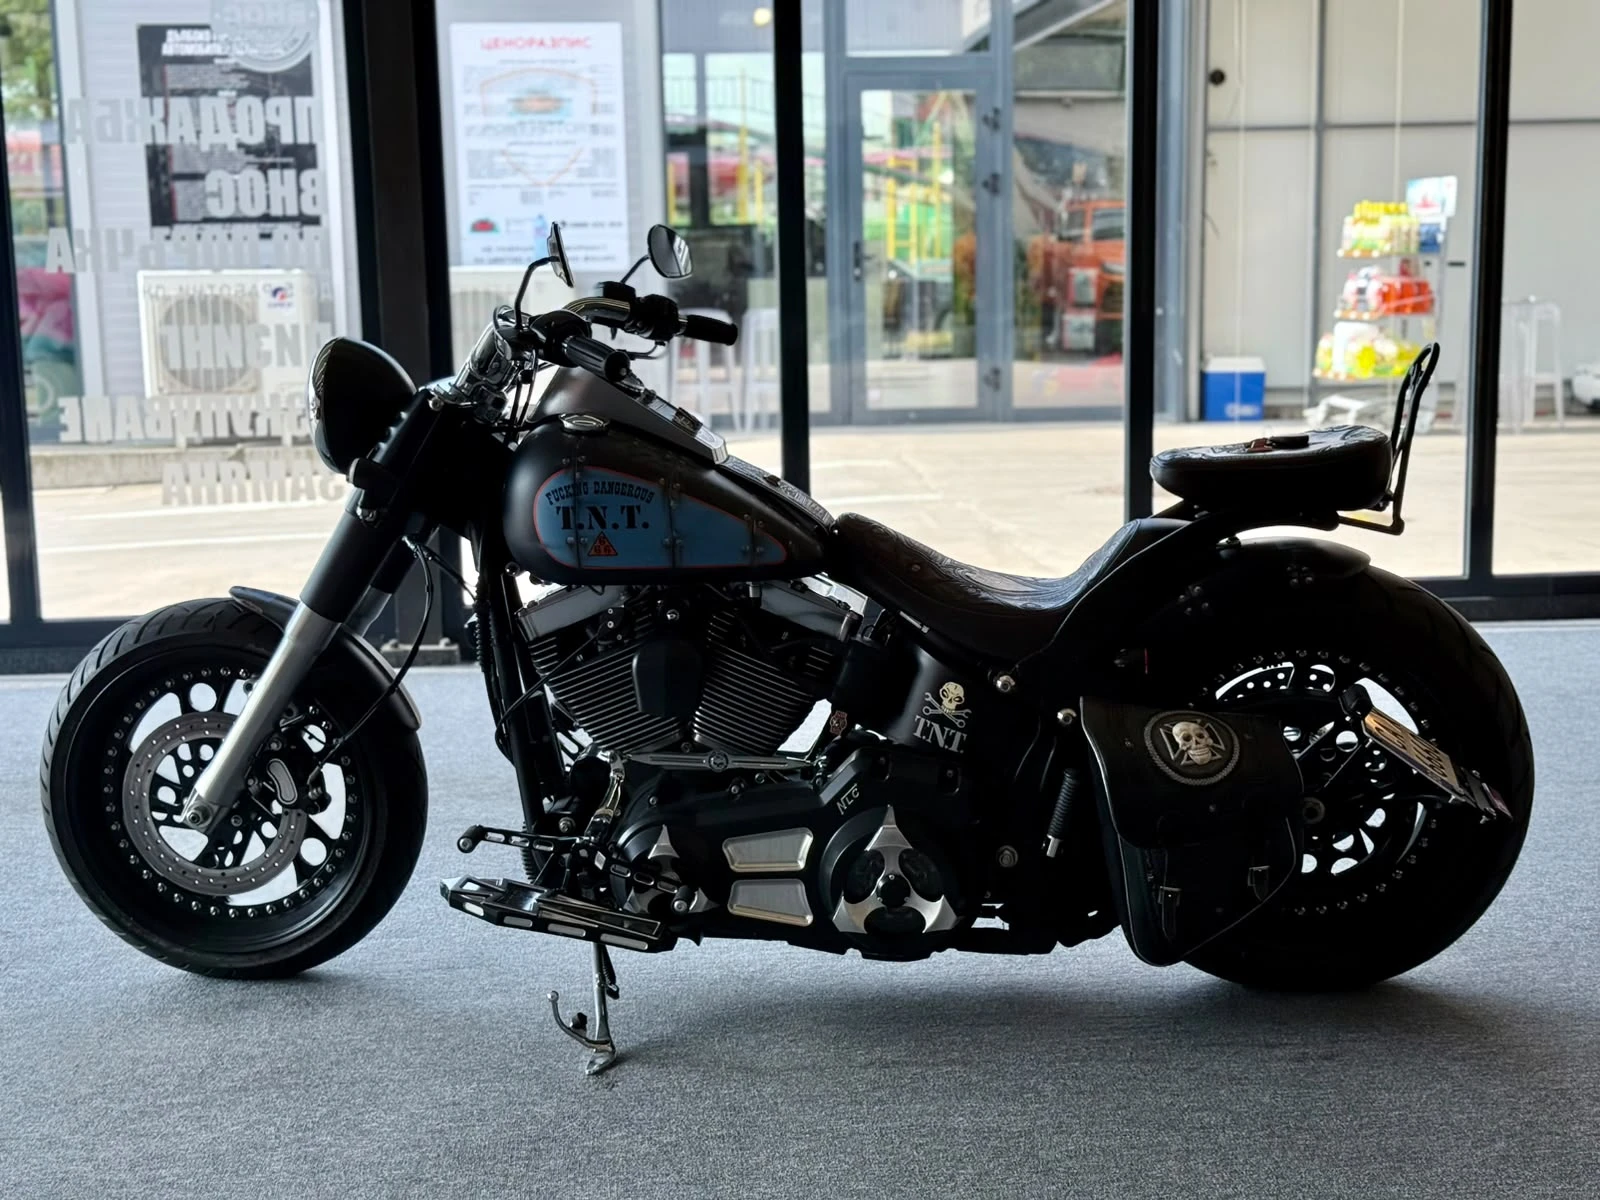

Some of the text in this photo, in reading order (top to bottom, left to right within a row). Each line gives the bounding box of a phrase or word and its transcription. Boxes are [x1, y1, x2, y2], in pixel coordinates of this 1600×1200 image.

[480, 36, 592, 50] ЦЕНОРАЗПИС
[545, 480, 655, 505] FUCKING DANGEROUS
[555, 504, 649, 530] T.N.T.
[912, 715, 968, 754] T.N.T.
[836, 783, 860, 815] NLC
